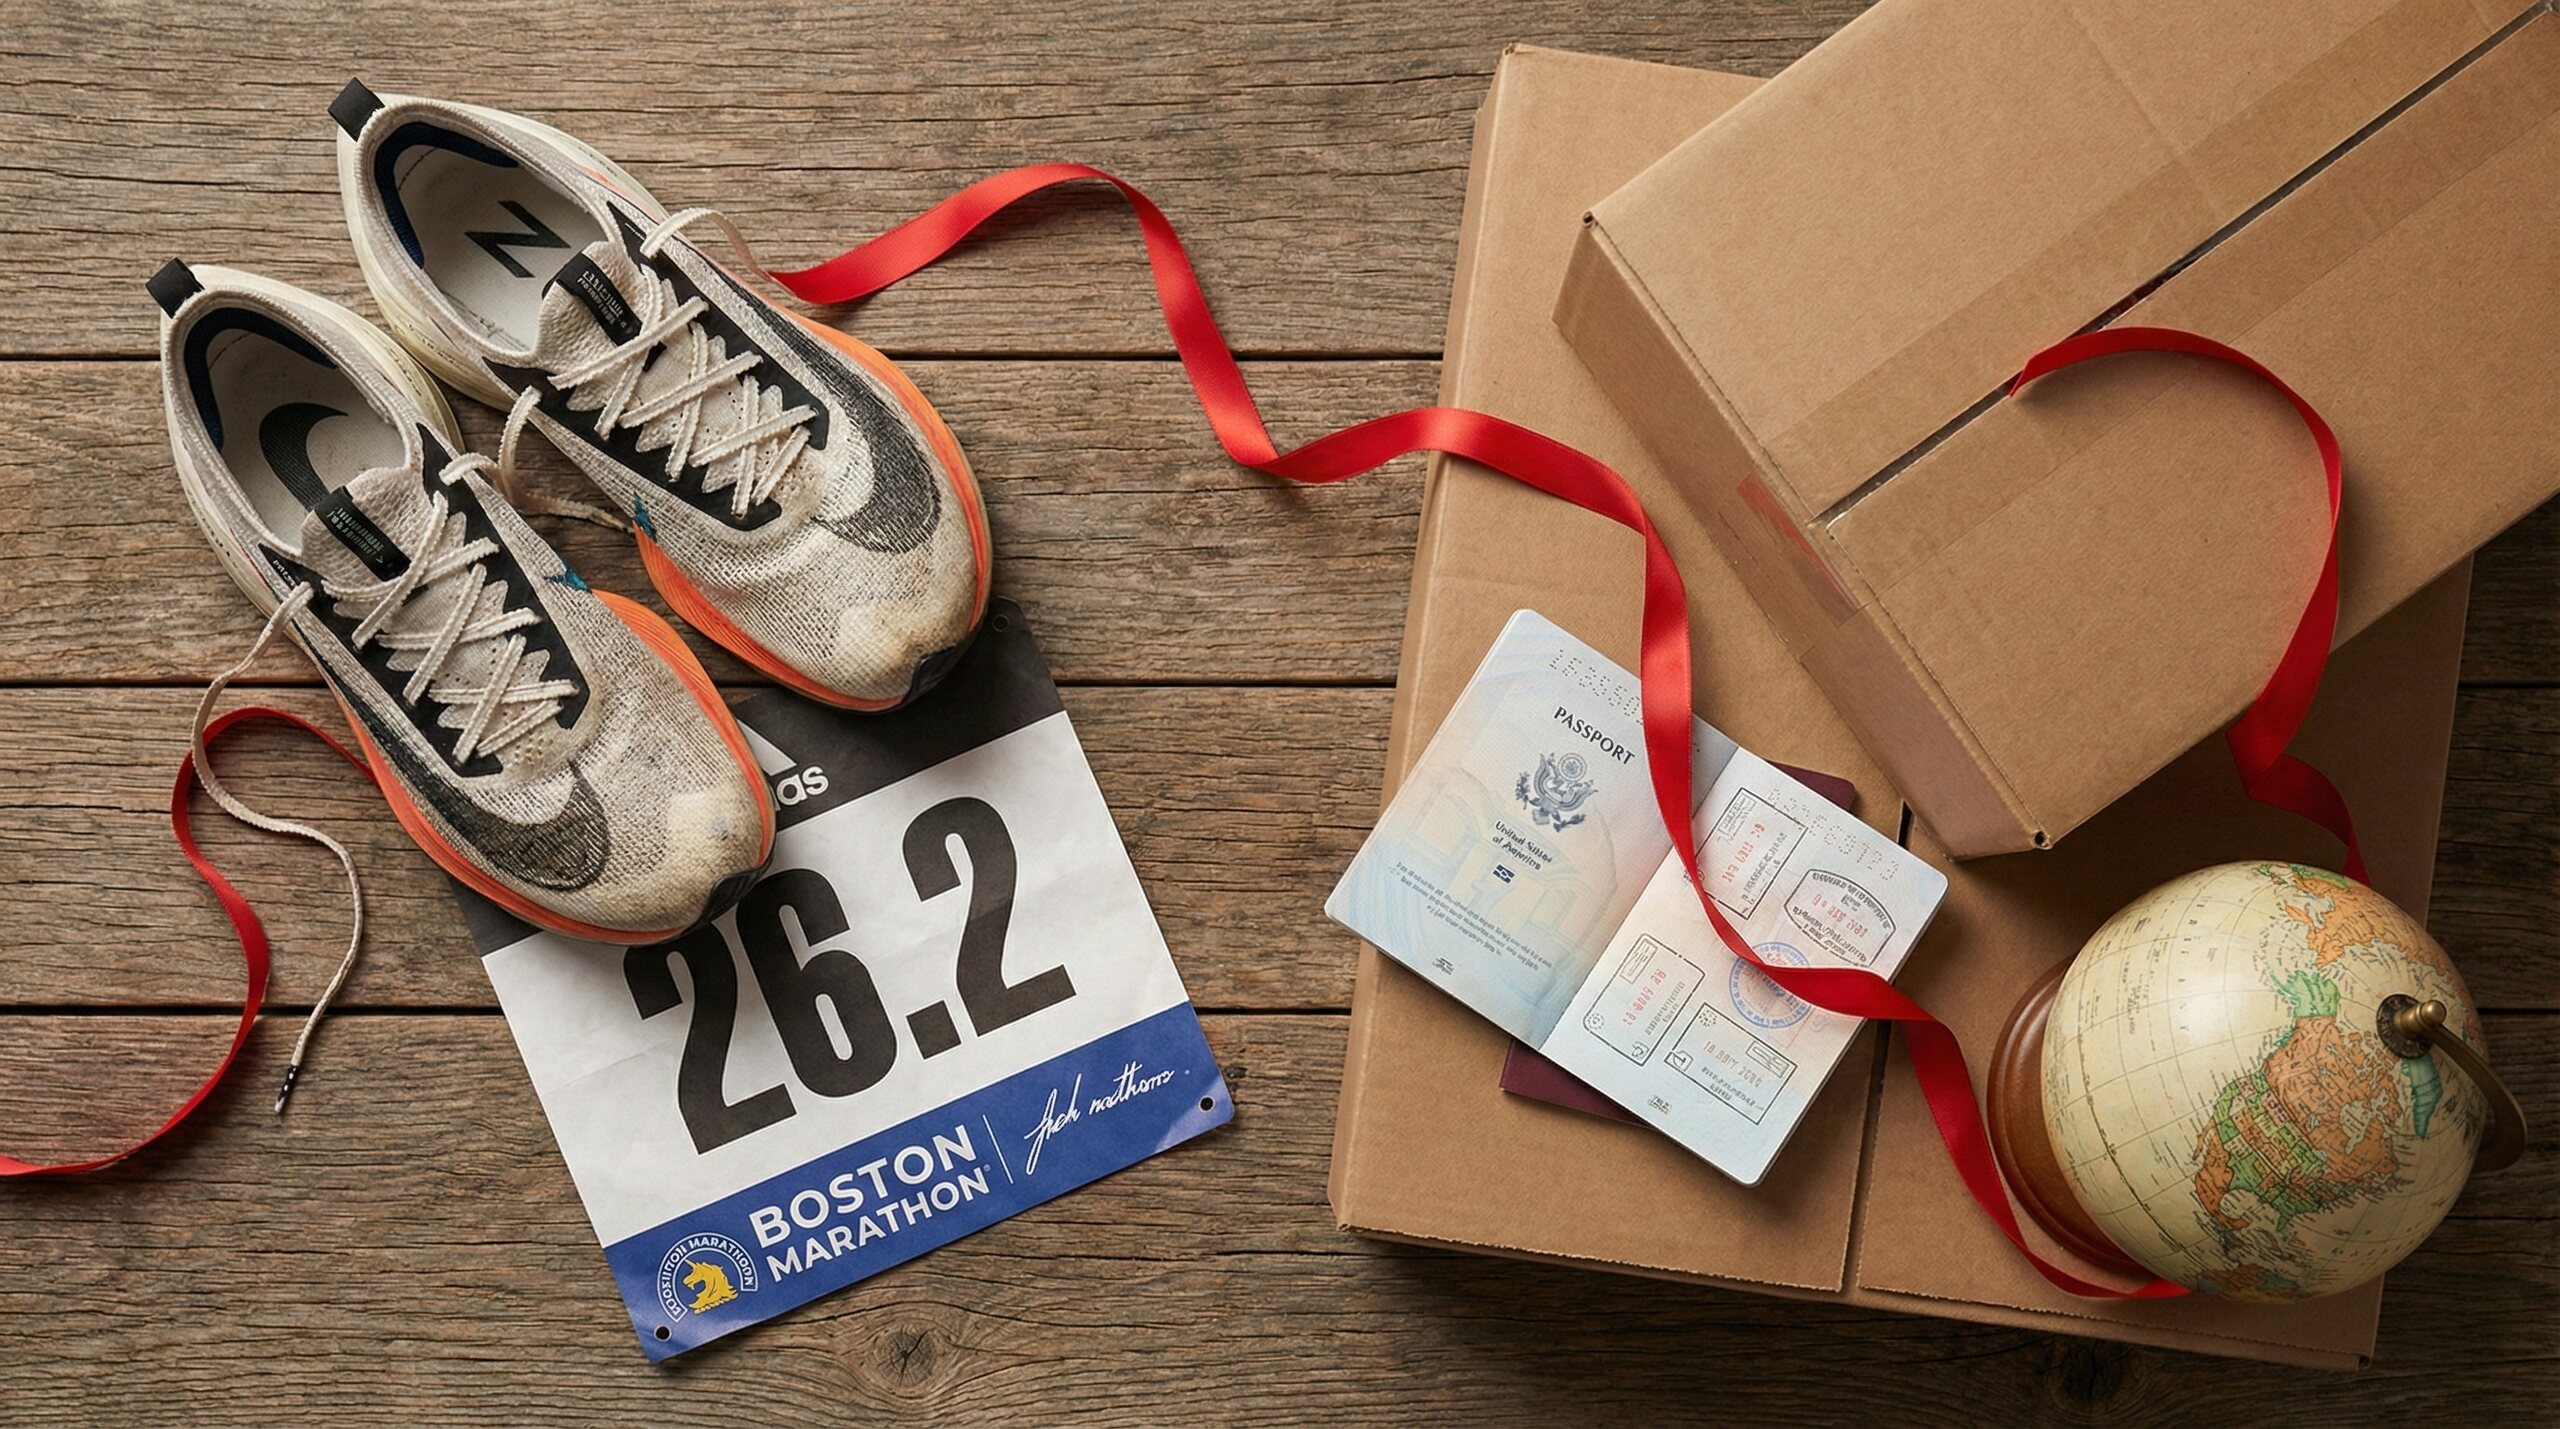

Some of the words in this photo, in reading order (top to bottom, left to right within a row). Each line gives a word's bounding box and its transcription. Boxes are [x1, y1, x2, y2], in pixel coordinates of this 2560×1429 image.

[1554, 706, 1635, 765] PASSPORT
[622, 797, 1076, 1155] 26.2
[748, 1124, 977, 1249] BOSTON
[766, 1167, 990, 1283] MARATHON
